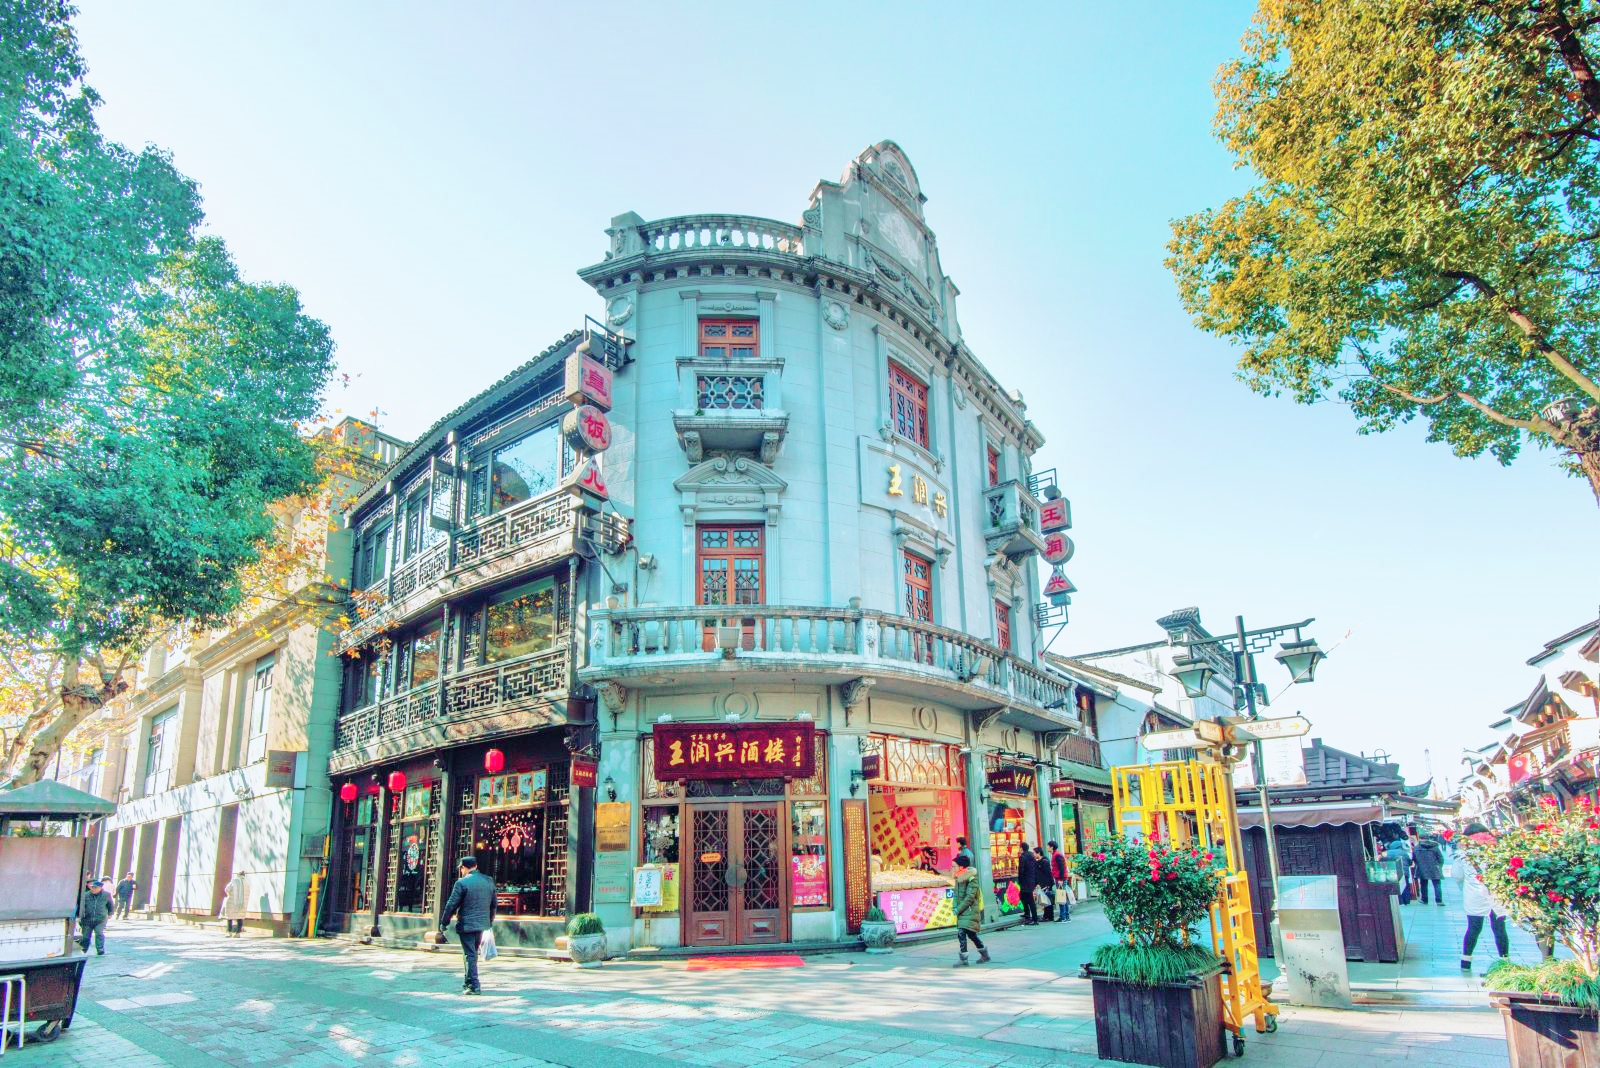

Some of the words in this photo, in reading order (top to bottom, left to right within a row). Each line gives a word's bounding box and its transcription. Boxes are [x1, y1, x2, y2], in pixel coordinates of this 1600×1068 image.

[1042, 505, 1066, 589] 王润兴
[1246, 720, 1281, 732] 西湖大道
[669, 736, 786, 767] 王润兴酒楼
